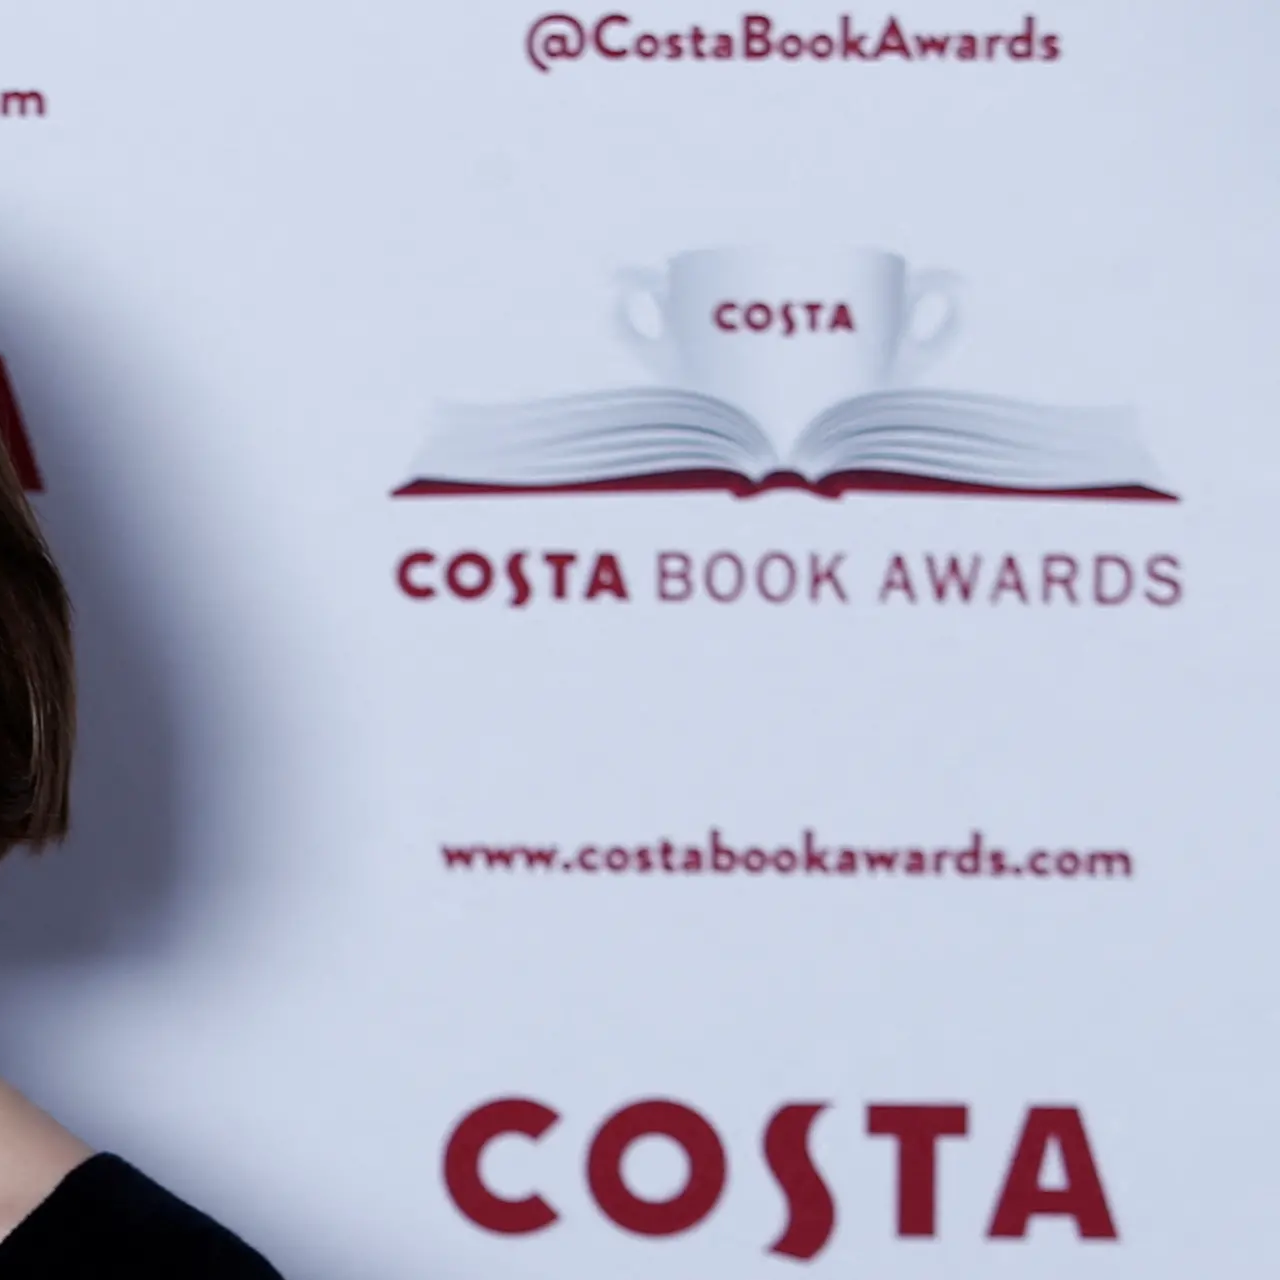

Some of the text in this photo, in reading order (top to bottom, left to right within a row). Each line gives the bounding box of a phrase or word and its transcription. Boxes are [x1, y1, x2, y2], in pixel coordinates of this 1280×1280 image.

[526, 13, 1060, 72] @CostaBookAwards
[714, 302, 854, 336] COSTA
[396, 551, 1182, 607] COSTA BOOK AWARDS
[441, 830, 1132, 877] www.costabookawards.com
[442, 1097, 1118, 1259] COSTA
